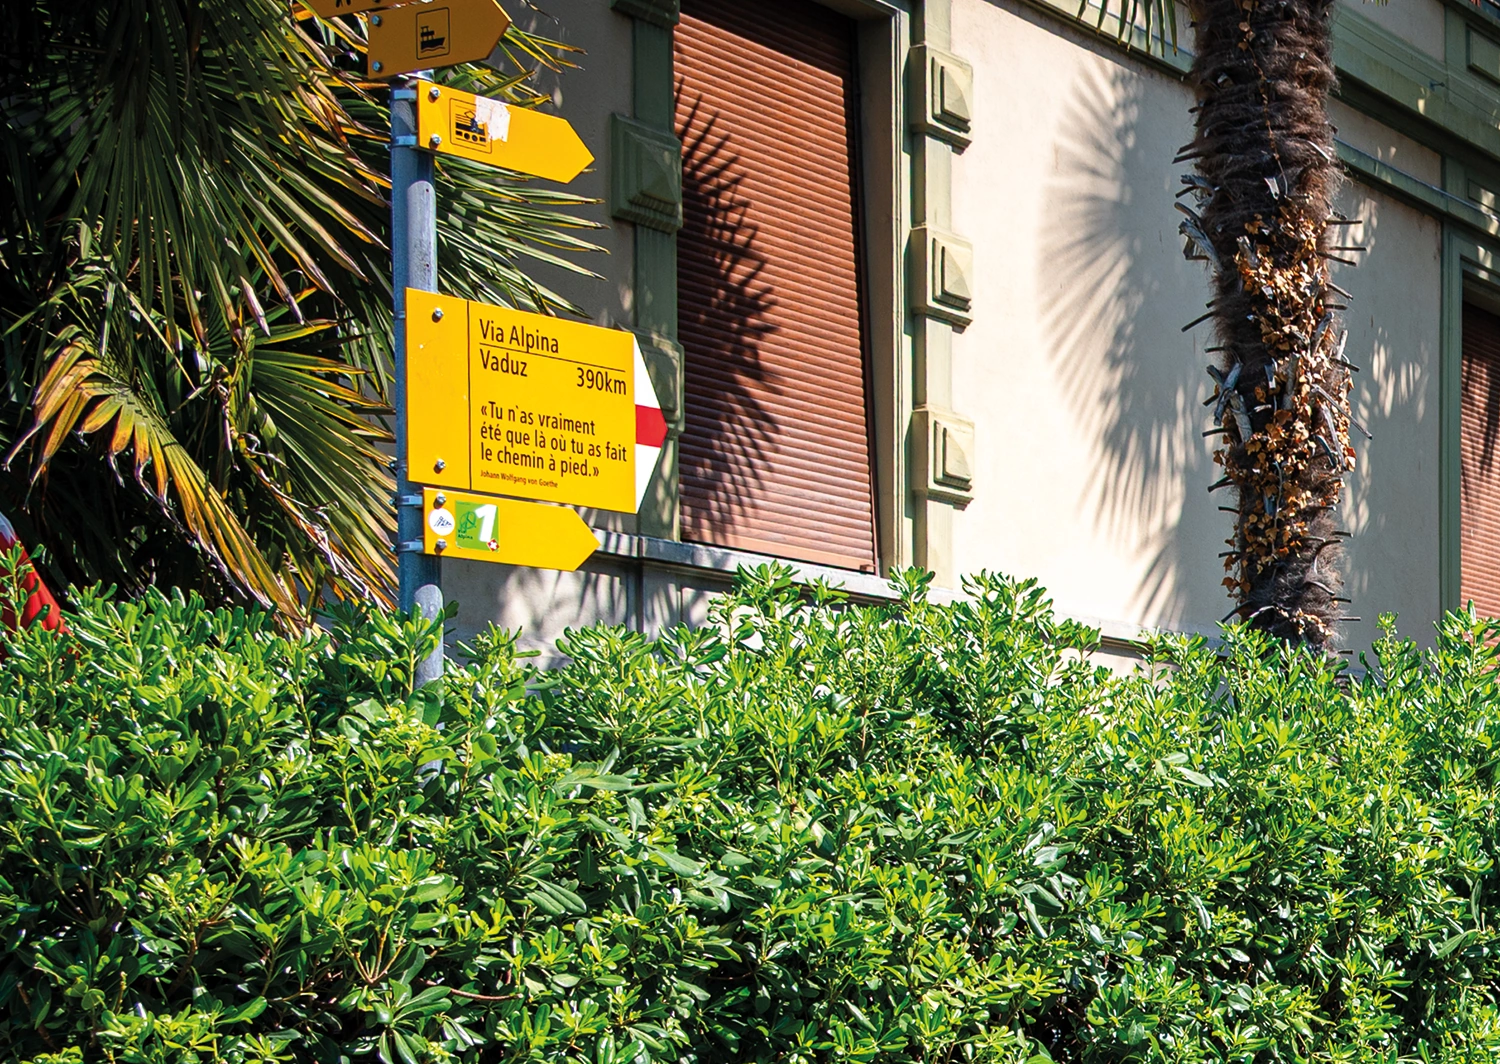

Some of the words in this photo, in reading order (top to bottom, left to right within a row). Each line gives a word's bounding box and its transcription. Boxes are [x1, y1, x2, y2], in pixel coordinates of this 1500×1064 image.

[479, 319, 504, 343] Via
[509, 325, 559, 354] Alpina
[480, 348, 528, 377] Vaduz
[576, 367, 627, 395] 390km
[480, 401, 503, 420] «Tu
[538, 413, 596, 436] vraiment
[480, 421, 502, 441] été
[506, 429, 531, 448] que
[534, 429, 546, 449] là
[550, 434, 567, 452] où
[571, 438, 584, 455] tu
[588, 443, 602, 458] as
[605, 441, 627, 462] fait
[480, 442, 493, 461] le
[497, 446, 544, 470] chemin
[548, 454, 556, 471] à
[560, 456, 600, 477] pied.»
[474, 504, 498, 542] 1
